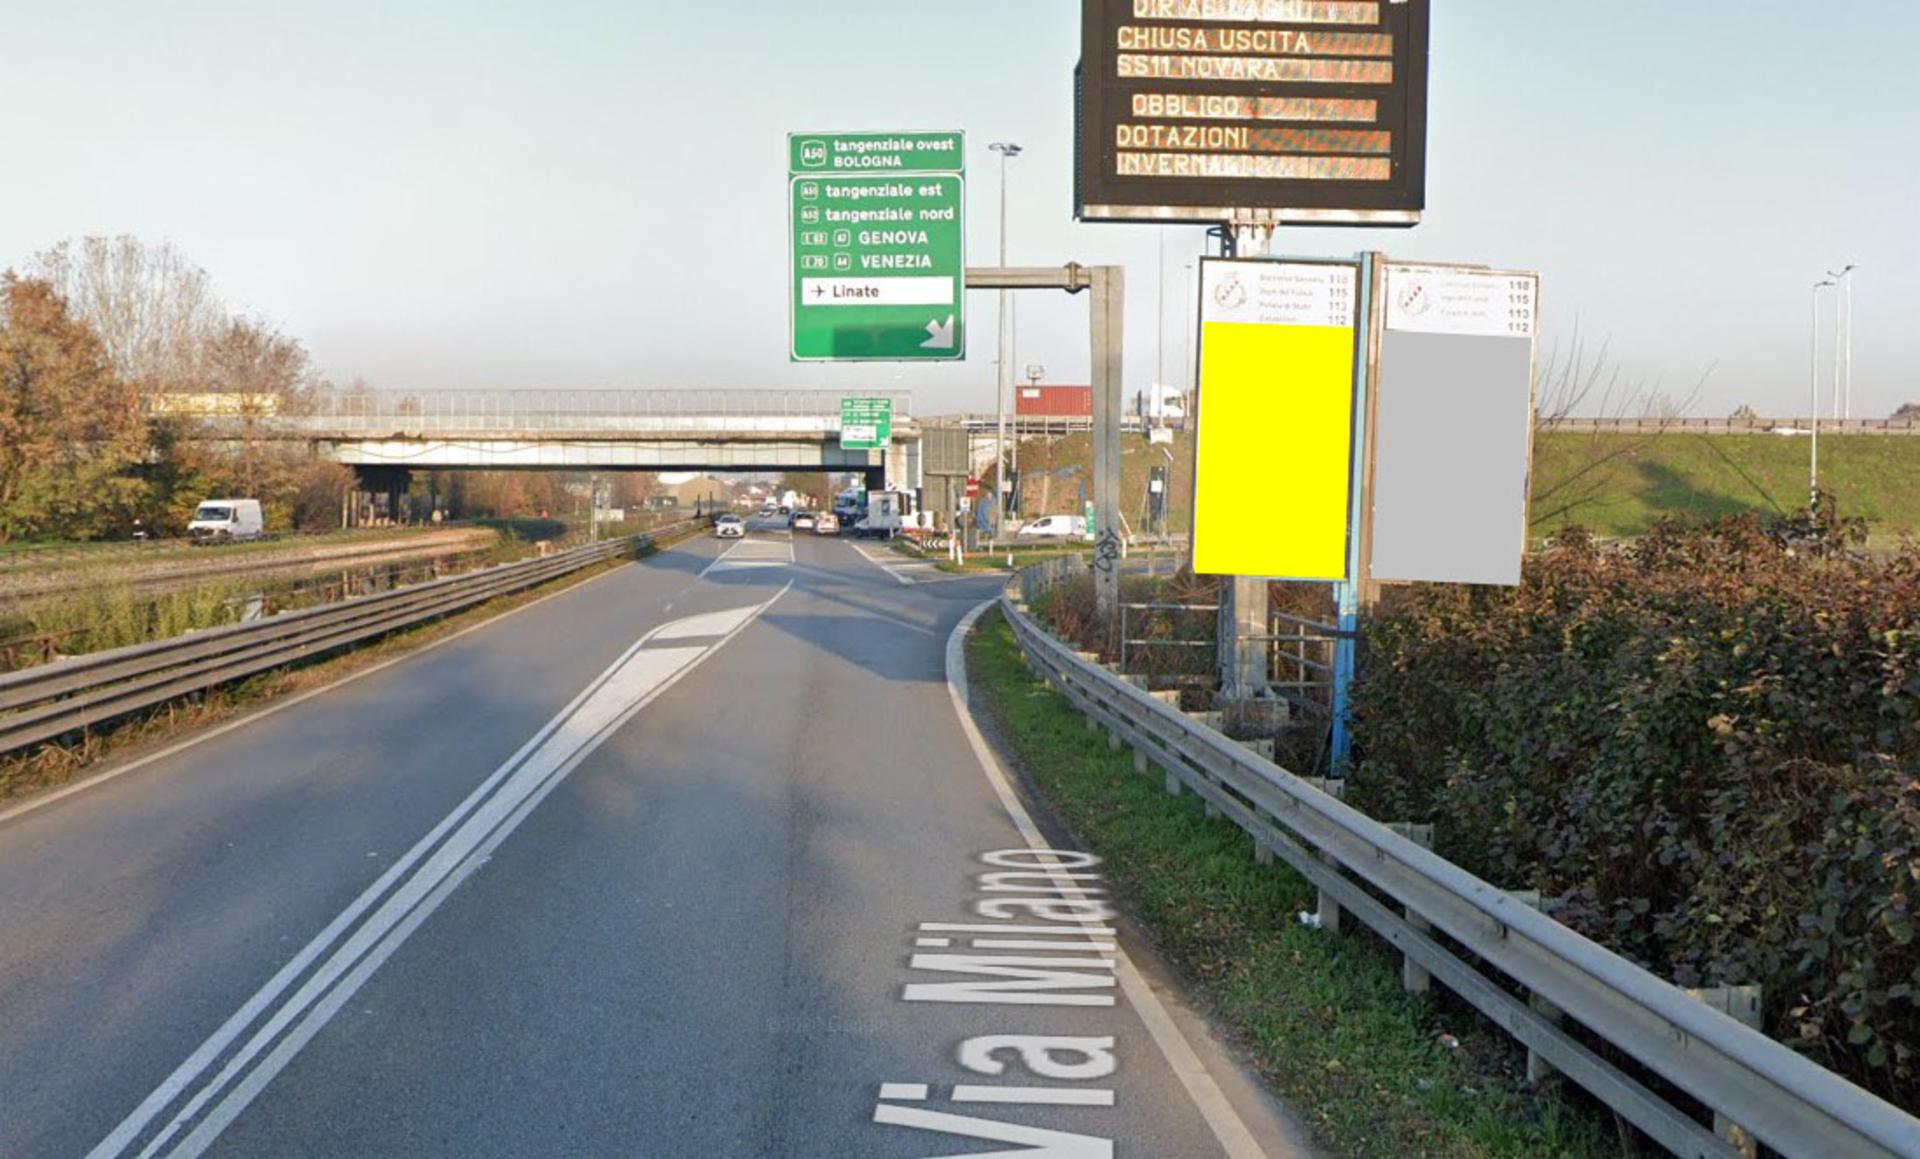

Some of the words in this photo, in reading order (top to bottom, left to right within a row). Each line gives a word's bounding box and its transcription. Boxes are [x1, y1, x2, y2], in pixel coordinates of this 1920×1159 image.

[1117, 26, 1207, 50] CHIUSA
[1220, 28, 1311, 53] USCITA
[1117, 54, 1171, 77] SS11
[1182, 56, 1279, 80] NOVARA
[1132, 94, 1240, 117] OBBLIGO
[1116, 124, 1249, 149] DOTAZIONI
[833, 138, 914, 153] tangenziale
[917, 138, 954, 151] ovest
[833, 155, 902, 168] BOLOGNA
[825, 183, 912, 200] tangenziale
[919, 184, 943, 197] est
[825, 207, 912, 224] tangenziale
[920, 207, 954, 220] nord
[858, 231, 928, 245] GENOVA
[861, 254, 932, 268] VENEZIA
[833, 284, 879, 298] Linate
[1329, 287, 1348, 297] 115
[1509, 281, 1530, 291] 118
[1328, 315, 1347, 326] 112
[1508, 308, 1529, 319] 113
[1508, 322, 1529, 333] 112
